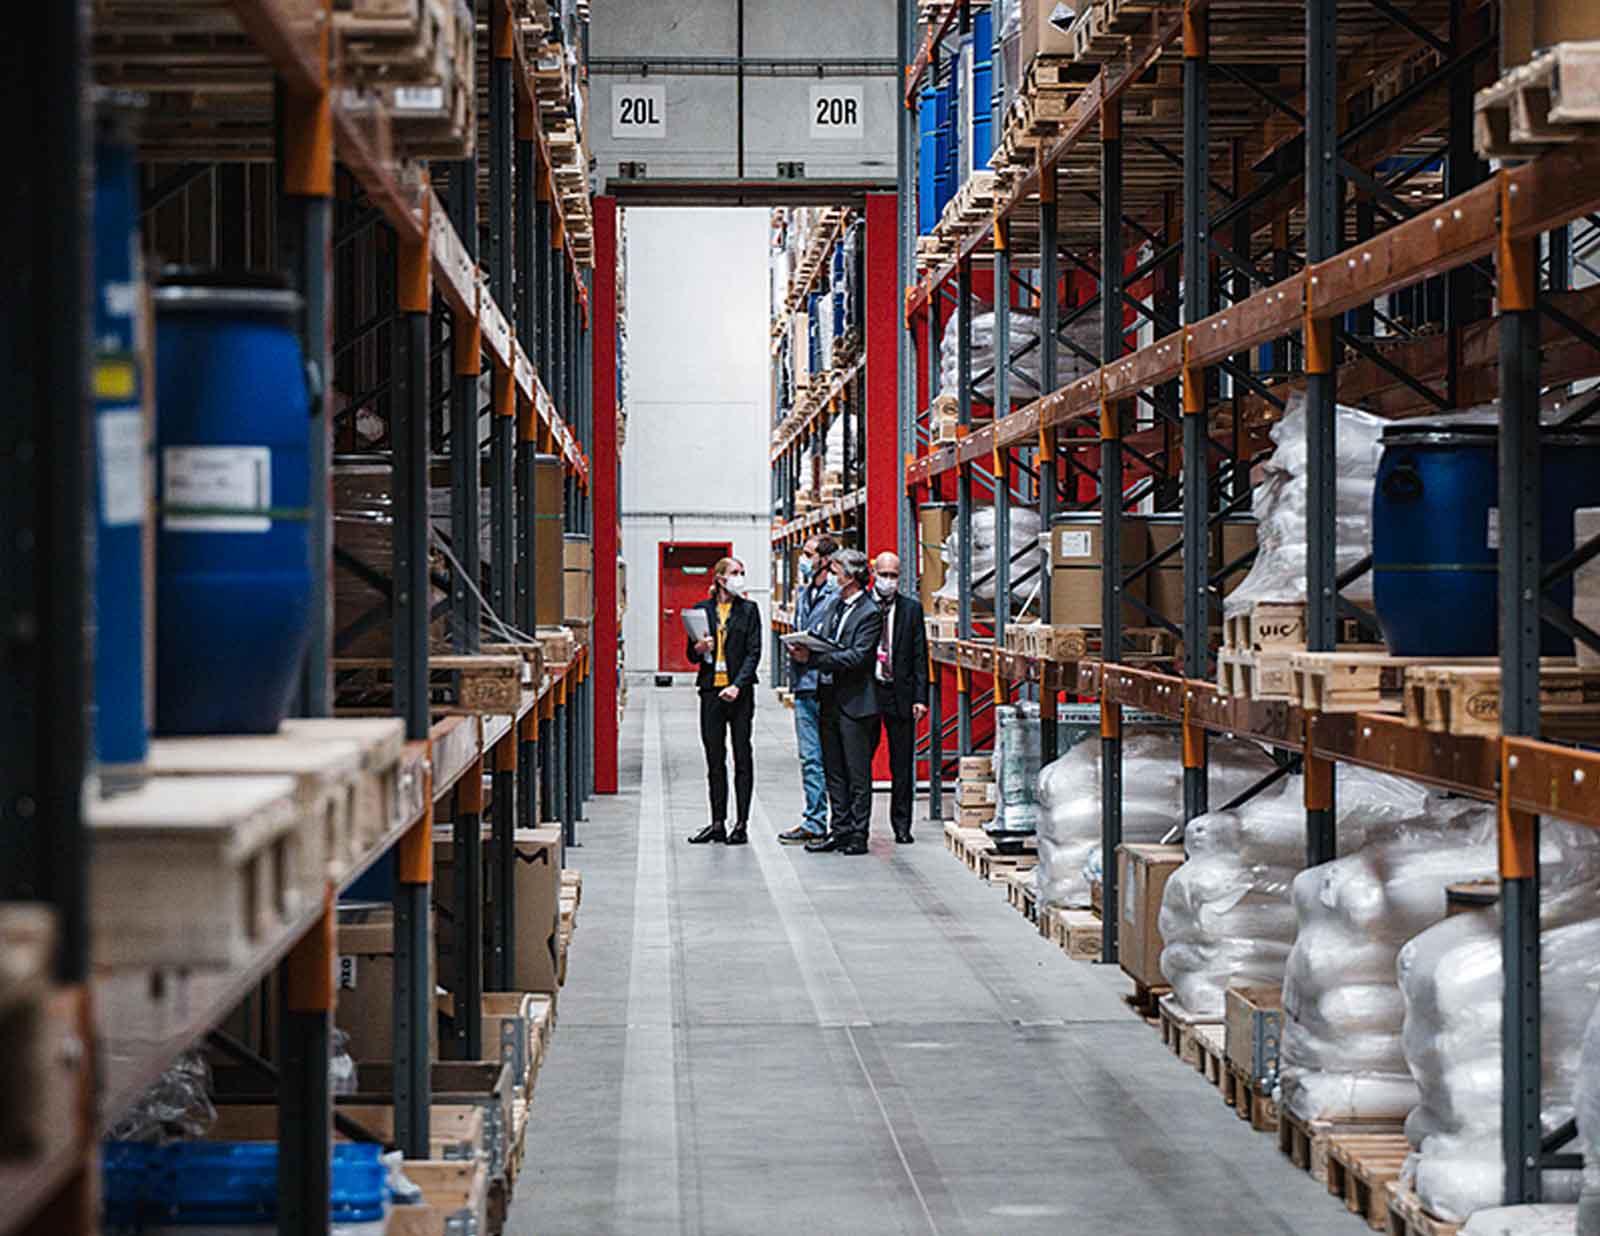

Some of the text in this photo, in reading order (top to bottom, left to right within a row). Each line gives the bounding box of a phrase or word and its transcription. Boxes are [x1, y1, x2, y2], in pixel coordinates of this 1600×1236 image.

[620, 97, 660, 125] 20L
[816, 97, 857, 125] 20R
[1259, 624, 1295, 637] UIC
